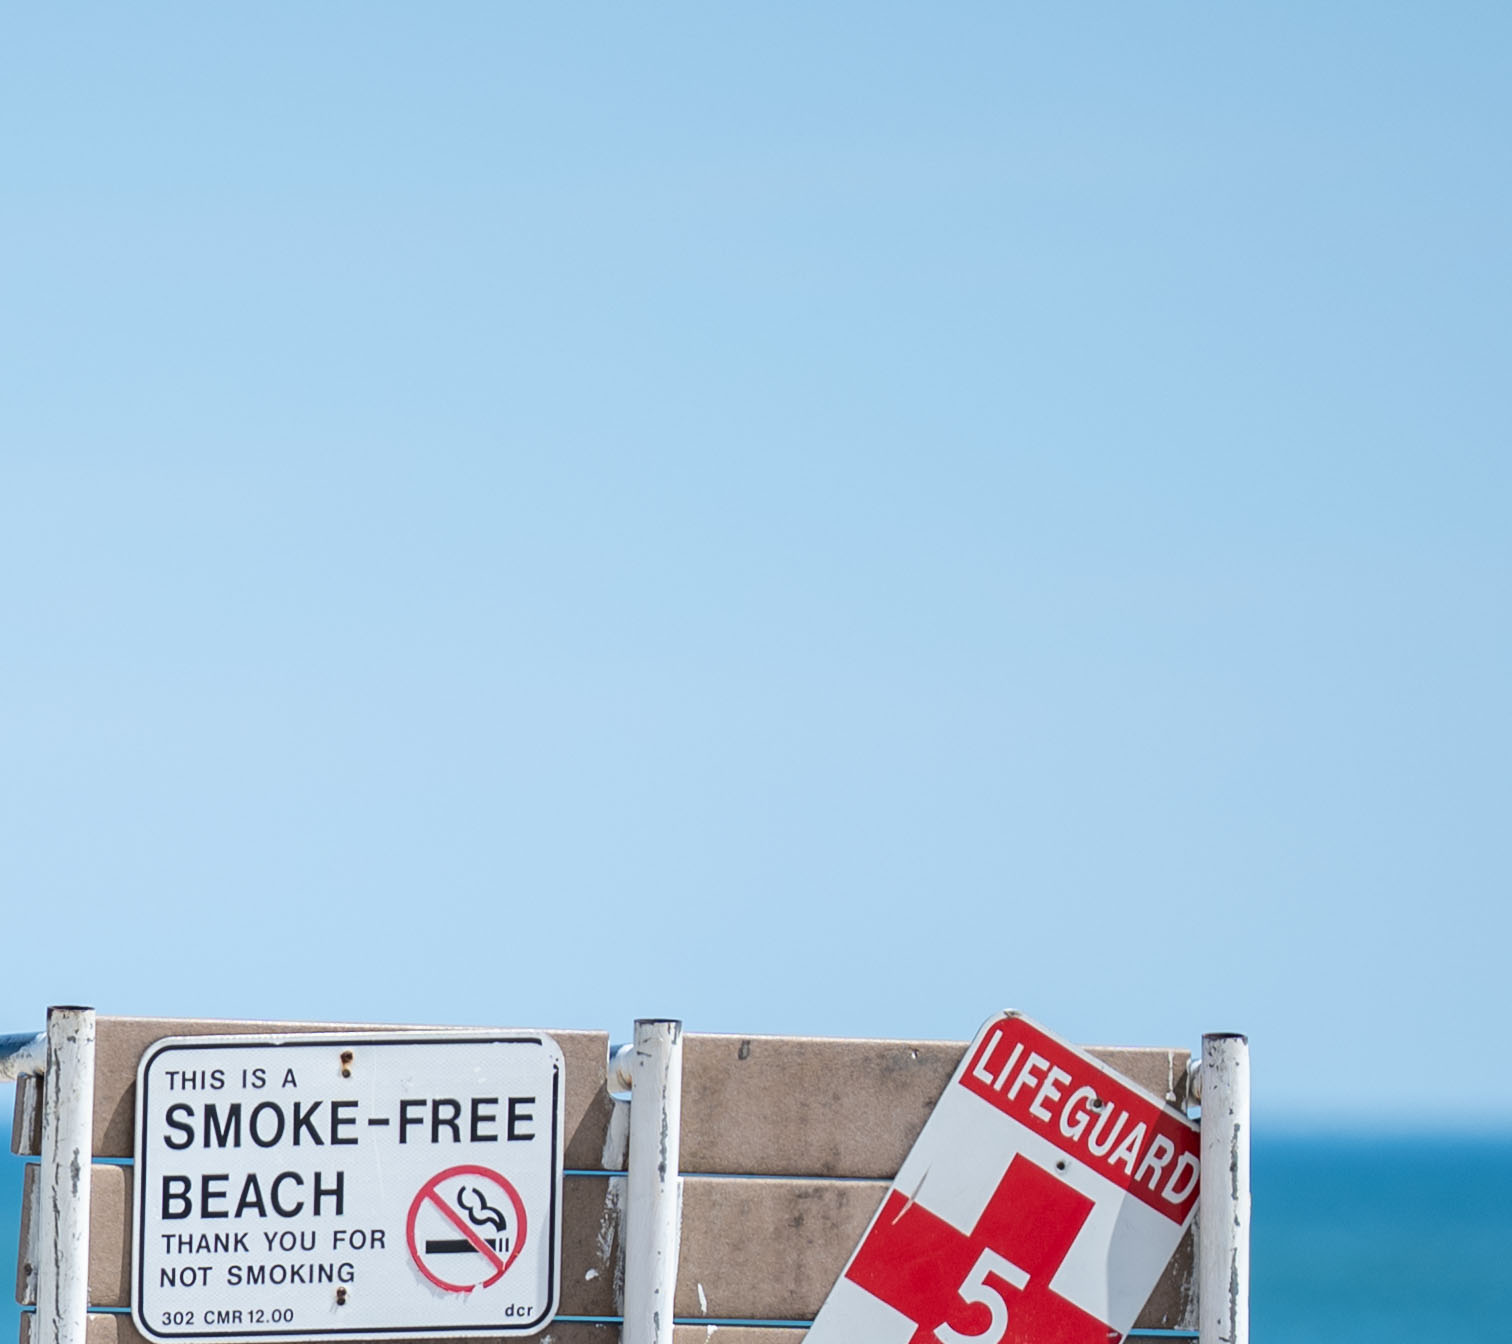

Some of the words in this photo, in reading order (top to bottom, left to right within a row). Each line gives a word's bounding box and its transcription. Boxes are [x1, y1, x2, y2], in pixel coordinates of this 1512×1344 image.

[165, 1069, 225, 1091] THIS
[242, 1068, 266, 1089] IS
[282, 1068, 297, 1088] A
[163, 1096, 536, 1151] SMOKE-FREE
[971, 1028, 1201, 1205] LIFEGUARD
[161, 1170, 345, 1220] BEACH
[161, 1232, 249, 1254] THANK
[263, 1230, 316, 1252] YOU
[333, 1229, 386, 1250] FOR
[160, 1266, 213, 1288] NOT
[227, 1262, 355, 1286] SMOKING
[162, 1311, 194, 1326] 302
[203, 1310, 243, 1325] CMR
[248, 1308, 294, 1324] 12.00
[504, 1303, 533, 1317] dcr
